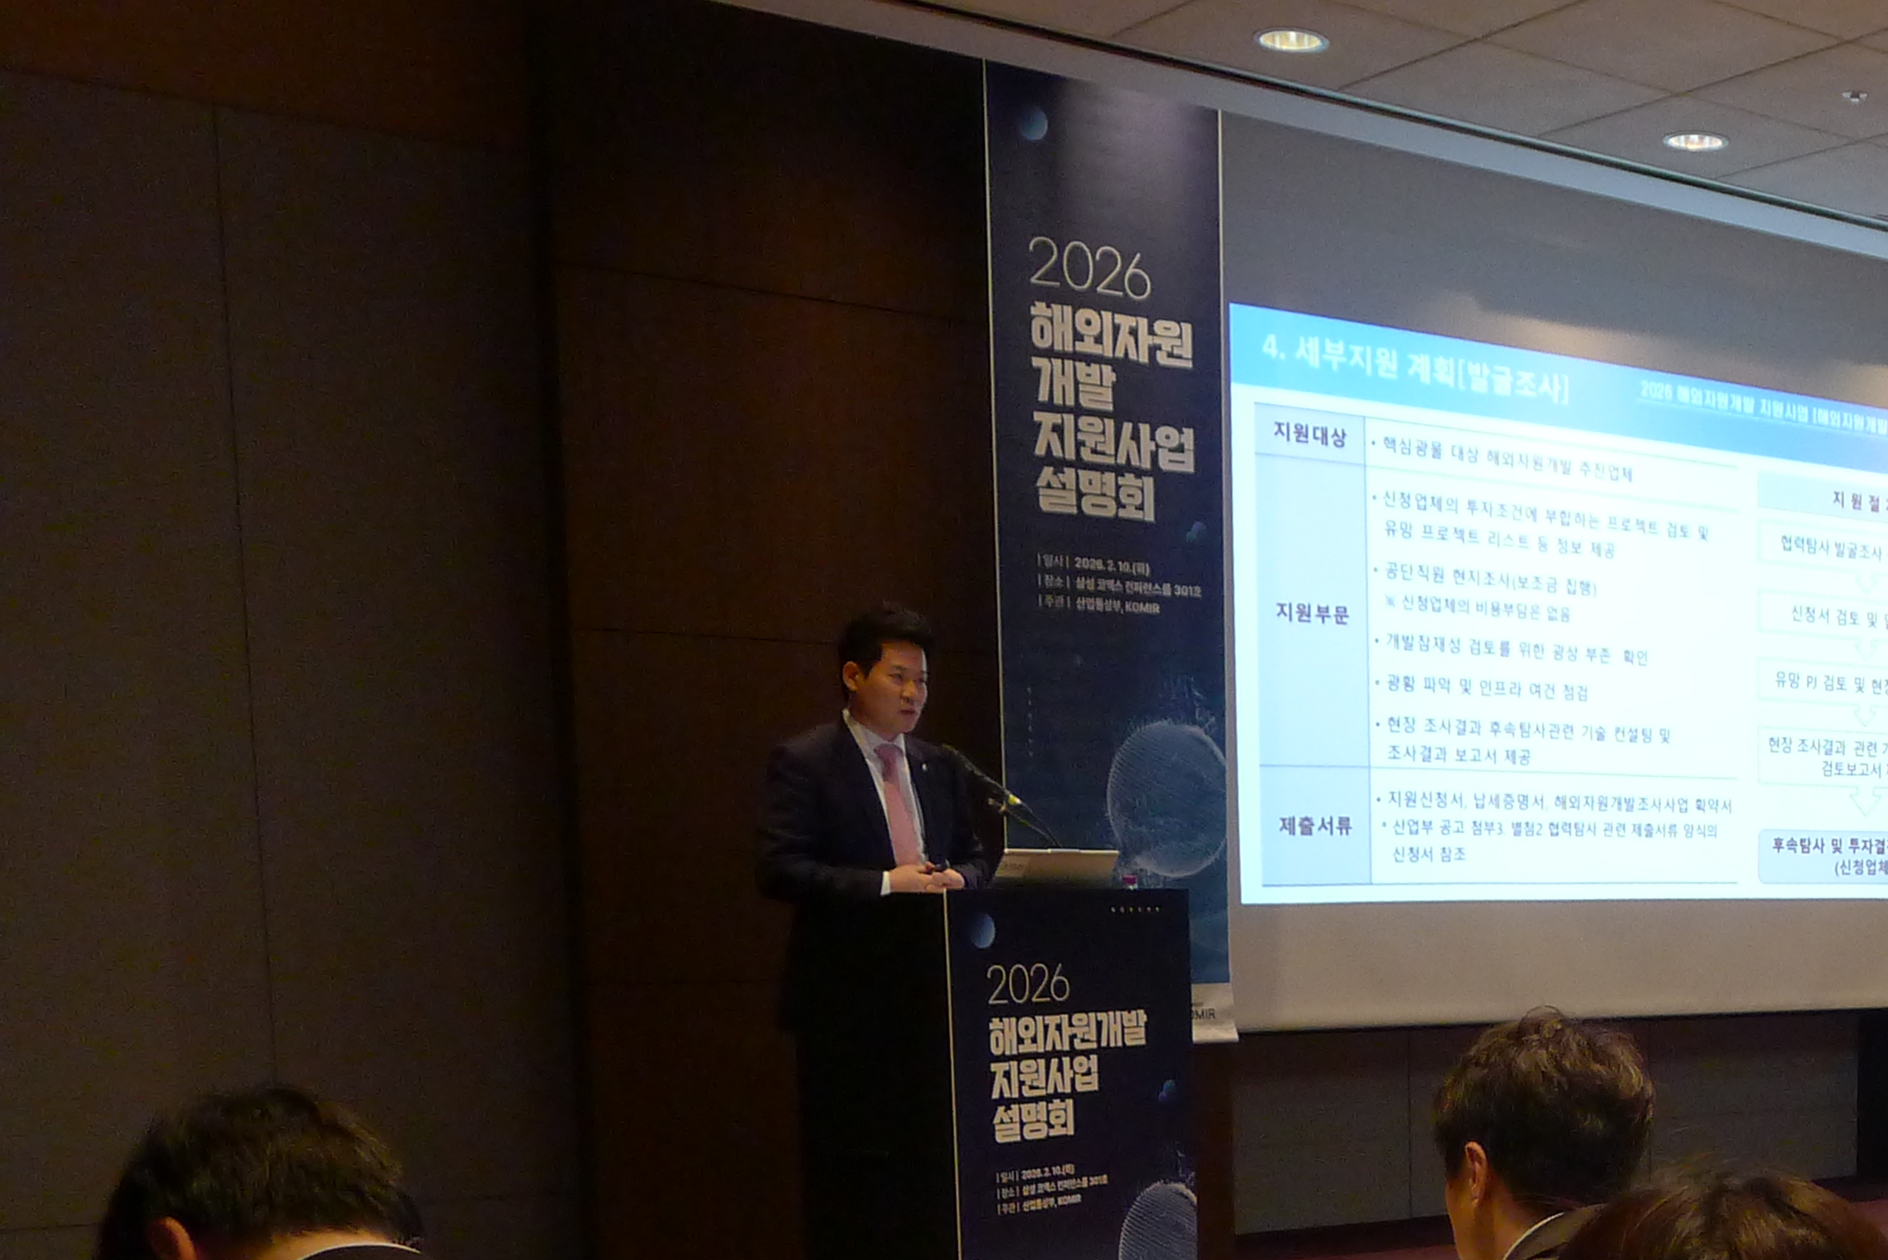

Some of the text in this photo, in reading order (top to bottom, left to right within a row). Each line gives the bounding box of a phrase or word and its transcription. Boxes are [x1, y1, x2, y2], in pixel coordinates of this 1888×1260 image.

[1029, 236, 1152, 300] 2026
[1030, 301, 1194, 369] 해외자원
[1032, 357, 1116, 411] 개발
[1263, 334, 1570, 405] 4. 세부지원 계획[발굴조사]
[1640, 379, 1673, 399] 2026
[1033, 411, 1196, 474] 지원사업
[1274, 421, 1348, 448] 지원대상
[1383, 435, 1634, 483] 핵심광물 대상 해외자원개발 추진업체
[1036, 466, 1156, 523] 설명회
[1383, 489, 1710, 542] 신청업체의 투자조건에 부합하는 프로젝트 검토 및
[1384, 519, 1616, 560] 유망 프로젝트 리스트 등 정보 제공
[1781, 534, 1831, 557] 협력탐사
[1835, 541, 1882, 563] 발굴조사
[1384, 561, 1445, 585] 공단직원
[1566, 578, 1598, 598] 집행)
[1275, 601, 1350, 626] 지원부문
[1402, 594, 1471, 616] 신청업체의
[1546, 606, 1571, 624] 없음
[1791, 604, 1831, 625] 신청서
[1836, 609, 1860, 627] 검토
[1867, 611, 1878, 629] 및
[1386, 632, 1462, 654] 개발잠재성
[1469, 639, 1511, 659] 검토를
[1519, 641, 1545, 661] 위한
[1623, 648, 1649, 667] 확인
[1423, 676, 1451, 695] 파악
[1459, 677, 1472, 696] 및
[1479, 679, 1522, 698] 인프라
[1529, 682, 1556, 700] 여건
[1563, 684, 1589, 702] 점검
[1775, 671, 1800, 690] 유망
[1823, 675, 1848, 692] 검토
[1854, 677, 1866, 694] 및
[1387, 715, 1671, 745] 현장 조사결과 후속탐사관련 기술 컨설팅 및
[1387, 744, 1531, 767] 조사결과 보고서 제공
[1768, 735, 1793, 754] 현장
[1797, 738, 1846, 757] 조사결과
[1854, 741, 1878, 758] 관련
[1821, 760, 1882, 780] 검토보고서
[1554, 794, 1689, 814] 해외자원개발조사사업
[1695, 797, 1733, 815] 확약서
[1279, 815, 1353, 837] 제출서류
[1392, 818, 1434, 836] 산업부
[1439, 819, 1465, 836] 공고
[1511, 821, 1543, 838] 별첨2
[1548, 822, 1598, 838] 협력탐사
[1603, 822, 1627, 839] 관련
[1631, 822, 1679, 840] 제출서류
[1683, 823, 1718, 840] 양식의
[1392, 846, 1467, 864] 신청서 참조
[1772, 836, 1826, 855] 후속탐사
[1831, 838, 1844, 855] 및
[986, 963, 1071, 1004] 2026
[989, 1009, 1148, 1056] 해외자원개발
[990, 1054, 1100, 1100] 지원사업
[993, 1098, 1075, 1144] 설명회
